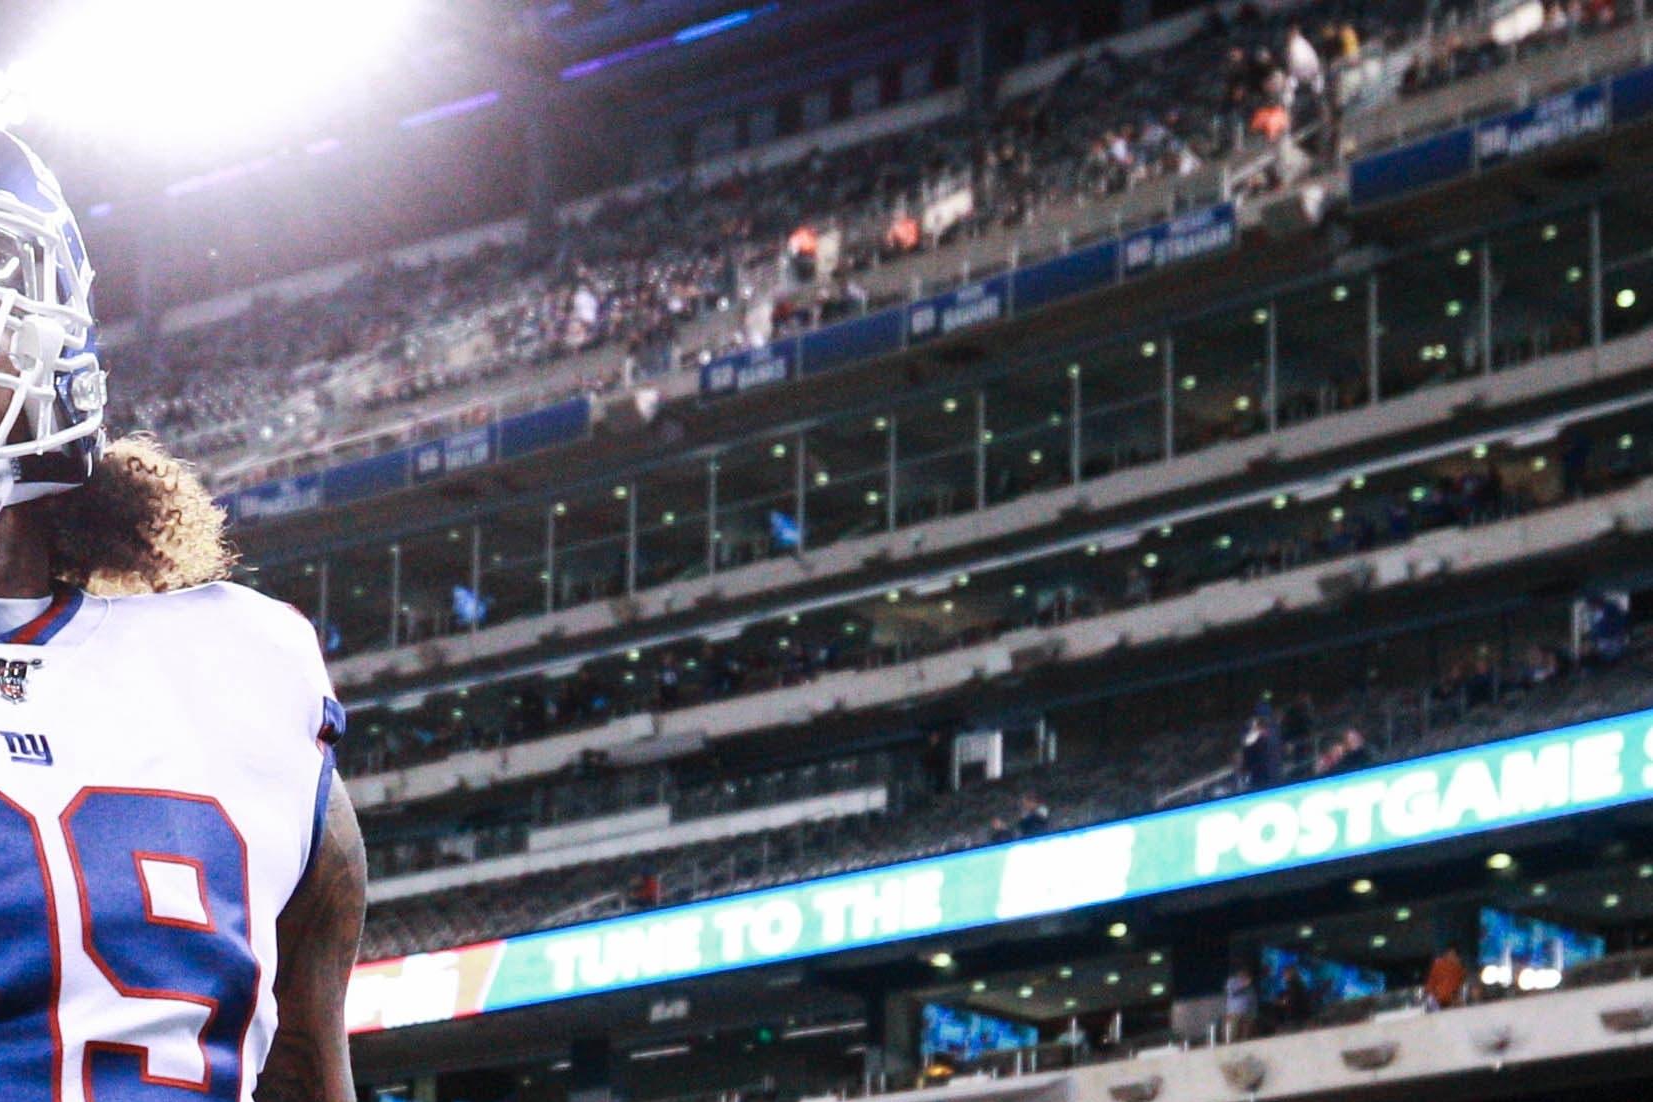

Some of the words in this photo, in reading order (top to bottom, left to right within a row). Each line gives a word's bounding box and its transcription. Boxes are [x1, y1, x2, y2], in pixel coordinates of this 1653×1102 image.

[1195, 732, 1624, 876] POSTGAME
[546, 916, 703, 991] TUNE
[714, 900, 803, 962] TO
[813, 870, 944, 944] THE
